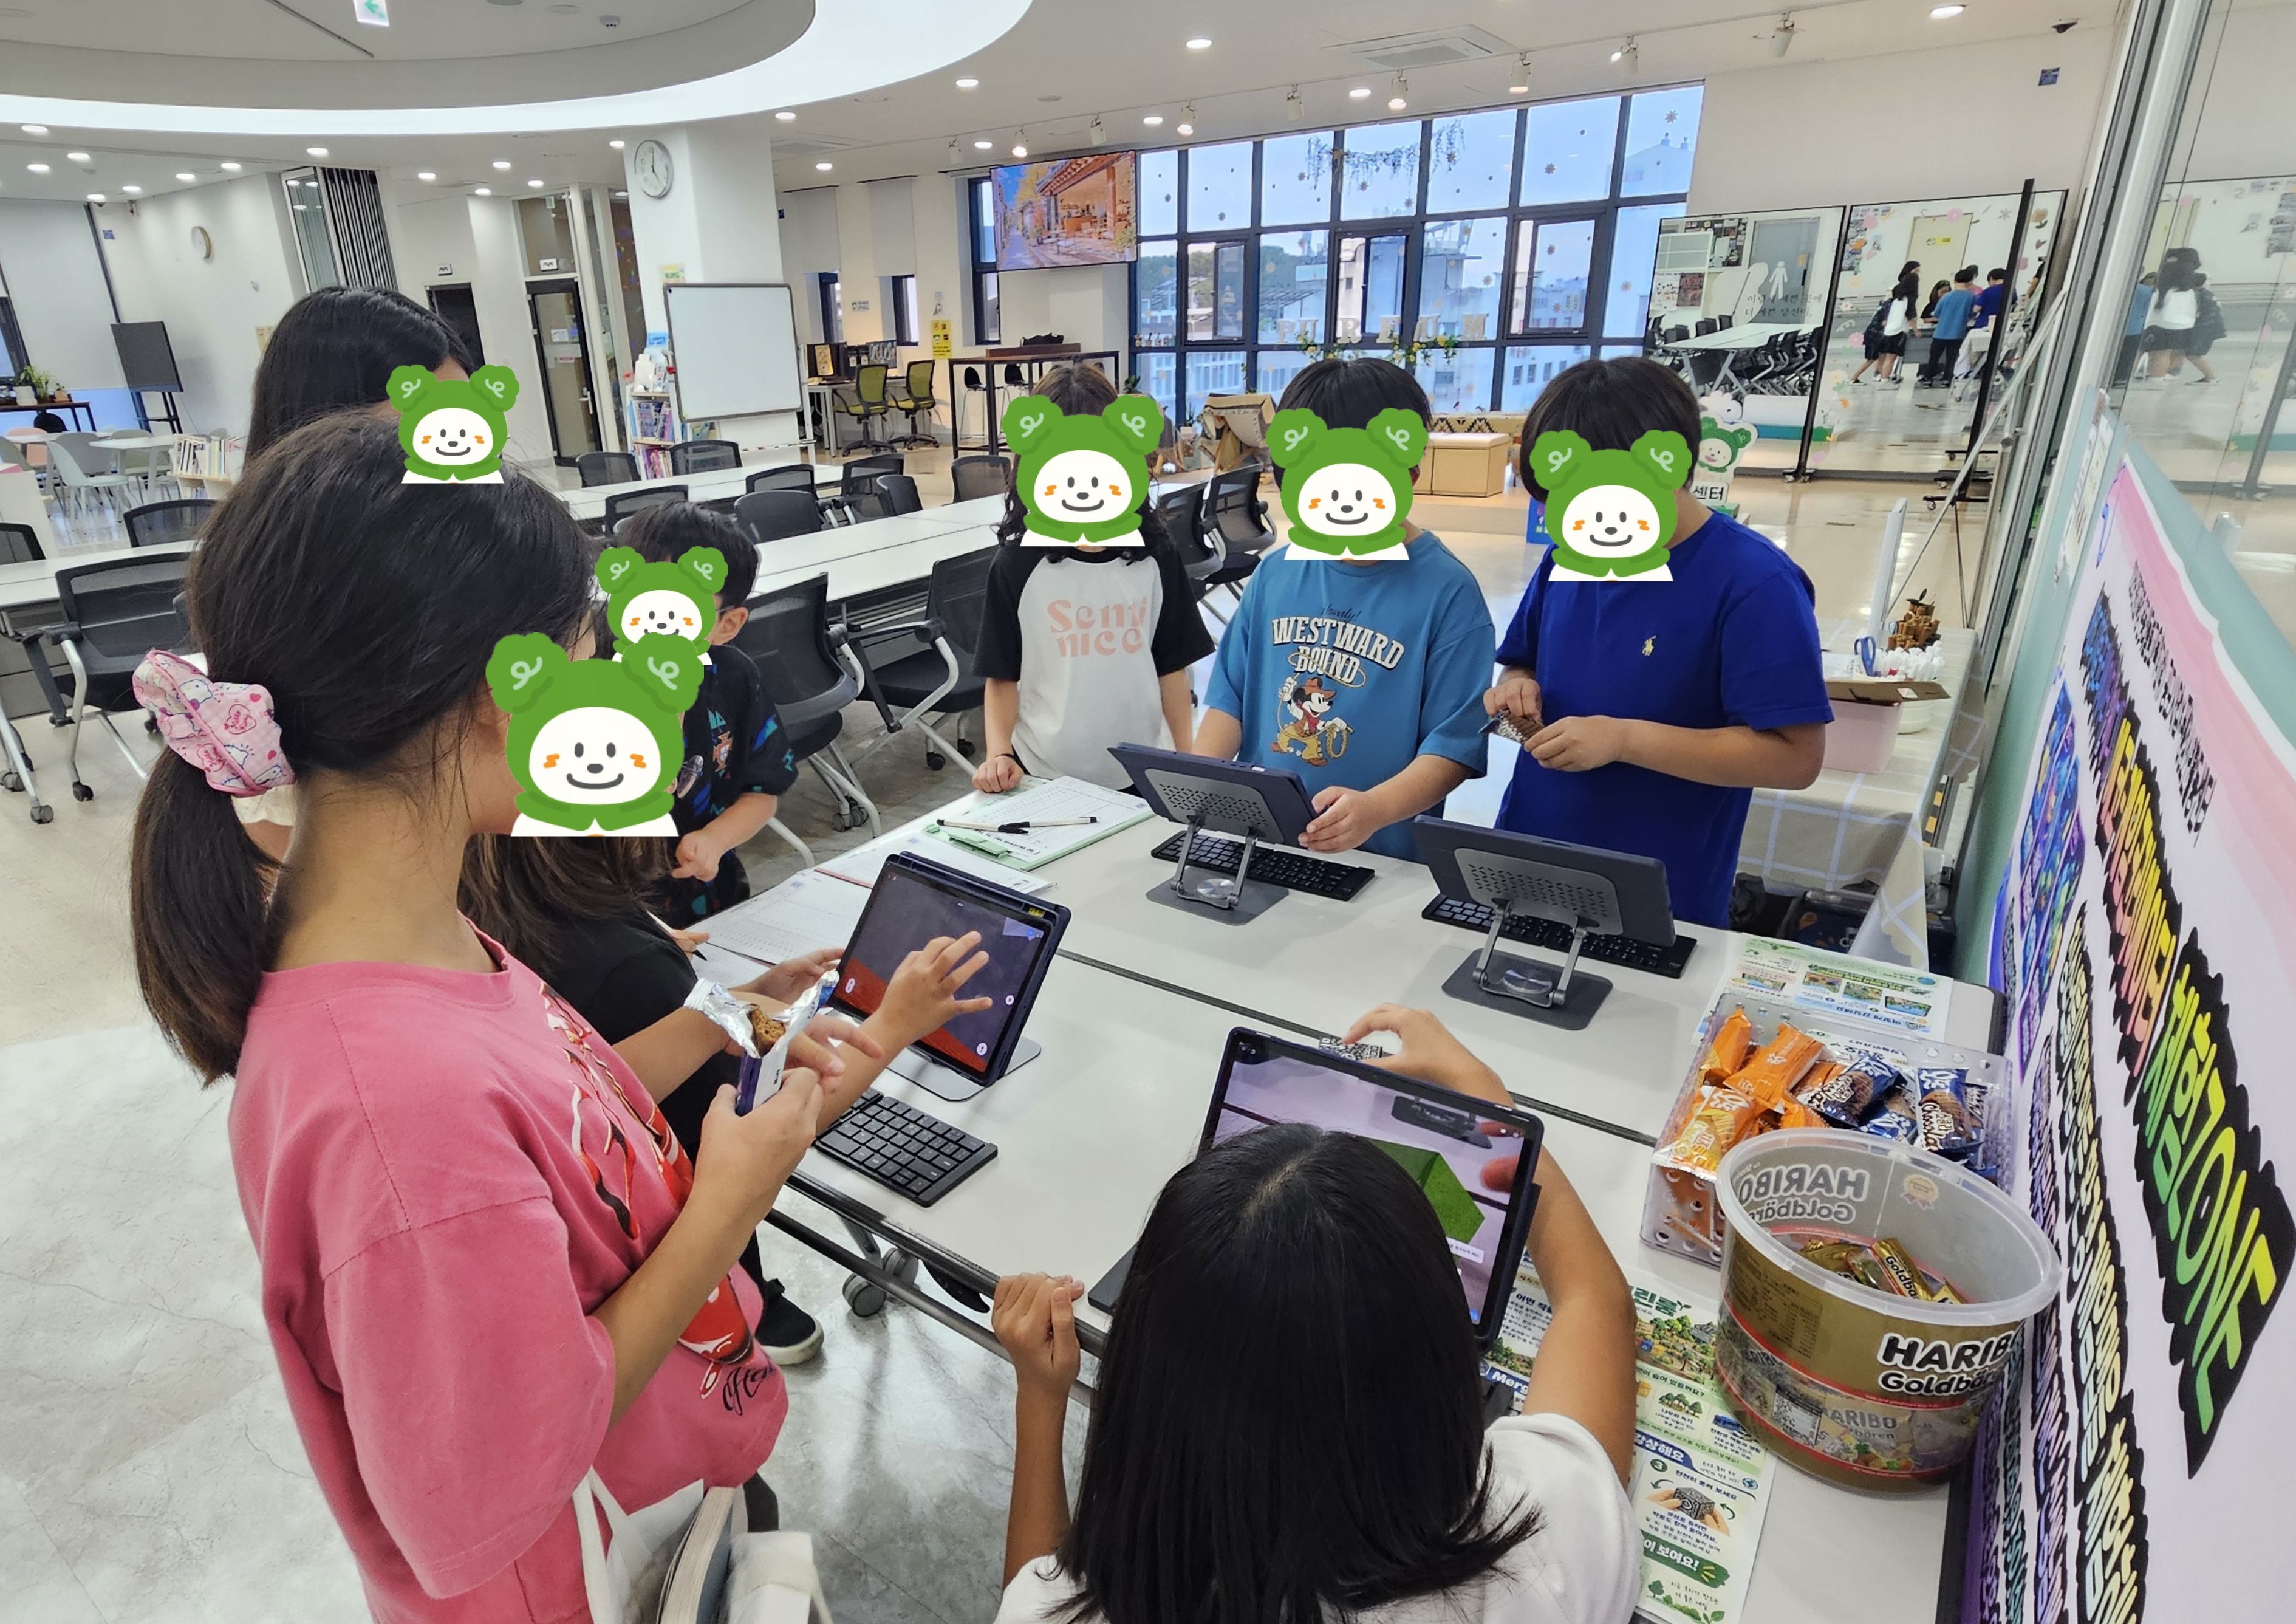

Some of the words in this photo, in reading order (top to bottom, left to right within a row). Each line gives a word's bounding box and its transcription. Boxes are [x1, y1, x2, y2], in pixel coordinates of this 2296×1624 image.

[1271, 615, 1406, 671] WESTWARD
[1296, 645, 1361, 686] BOUND
[1630, 1285, 1678, 1317] 린룸
[1492, 1371, 1529, 1395] Merg
[1655, 1460, 1663, 1470] 3
[1676, 1469, 1696, 1483] 천천히
[1715, 1486, 1737, 1501] 보세요
[1656, 1543, 1699, 1572] 보여요!
